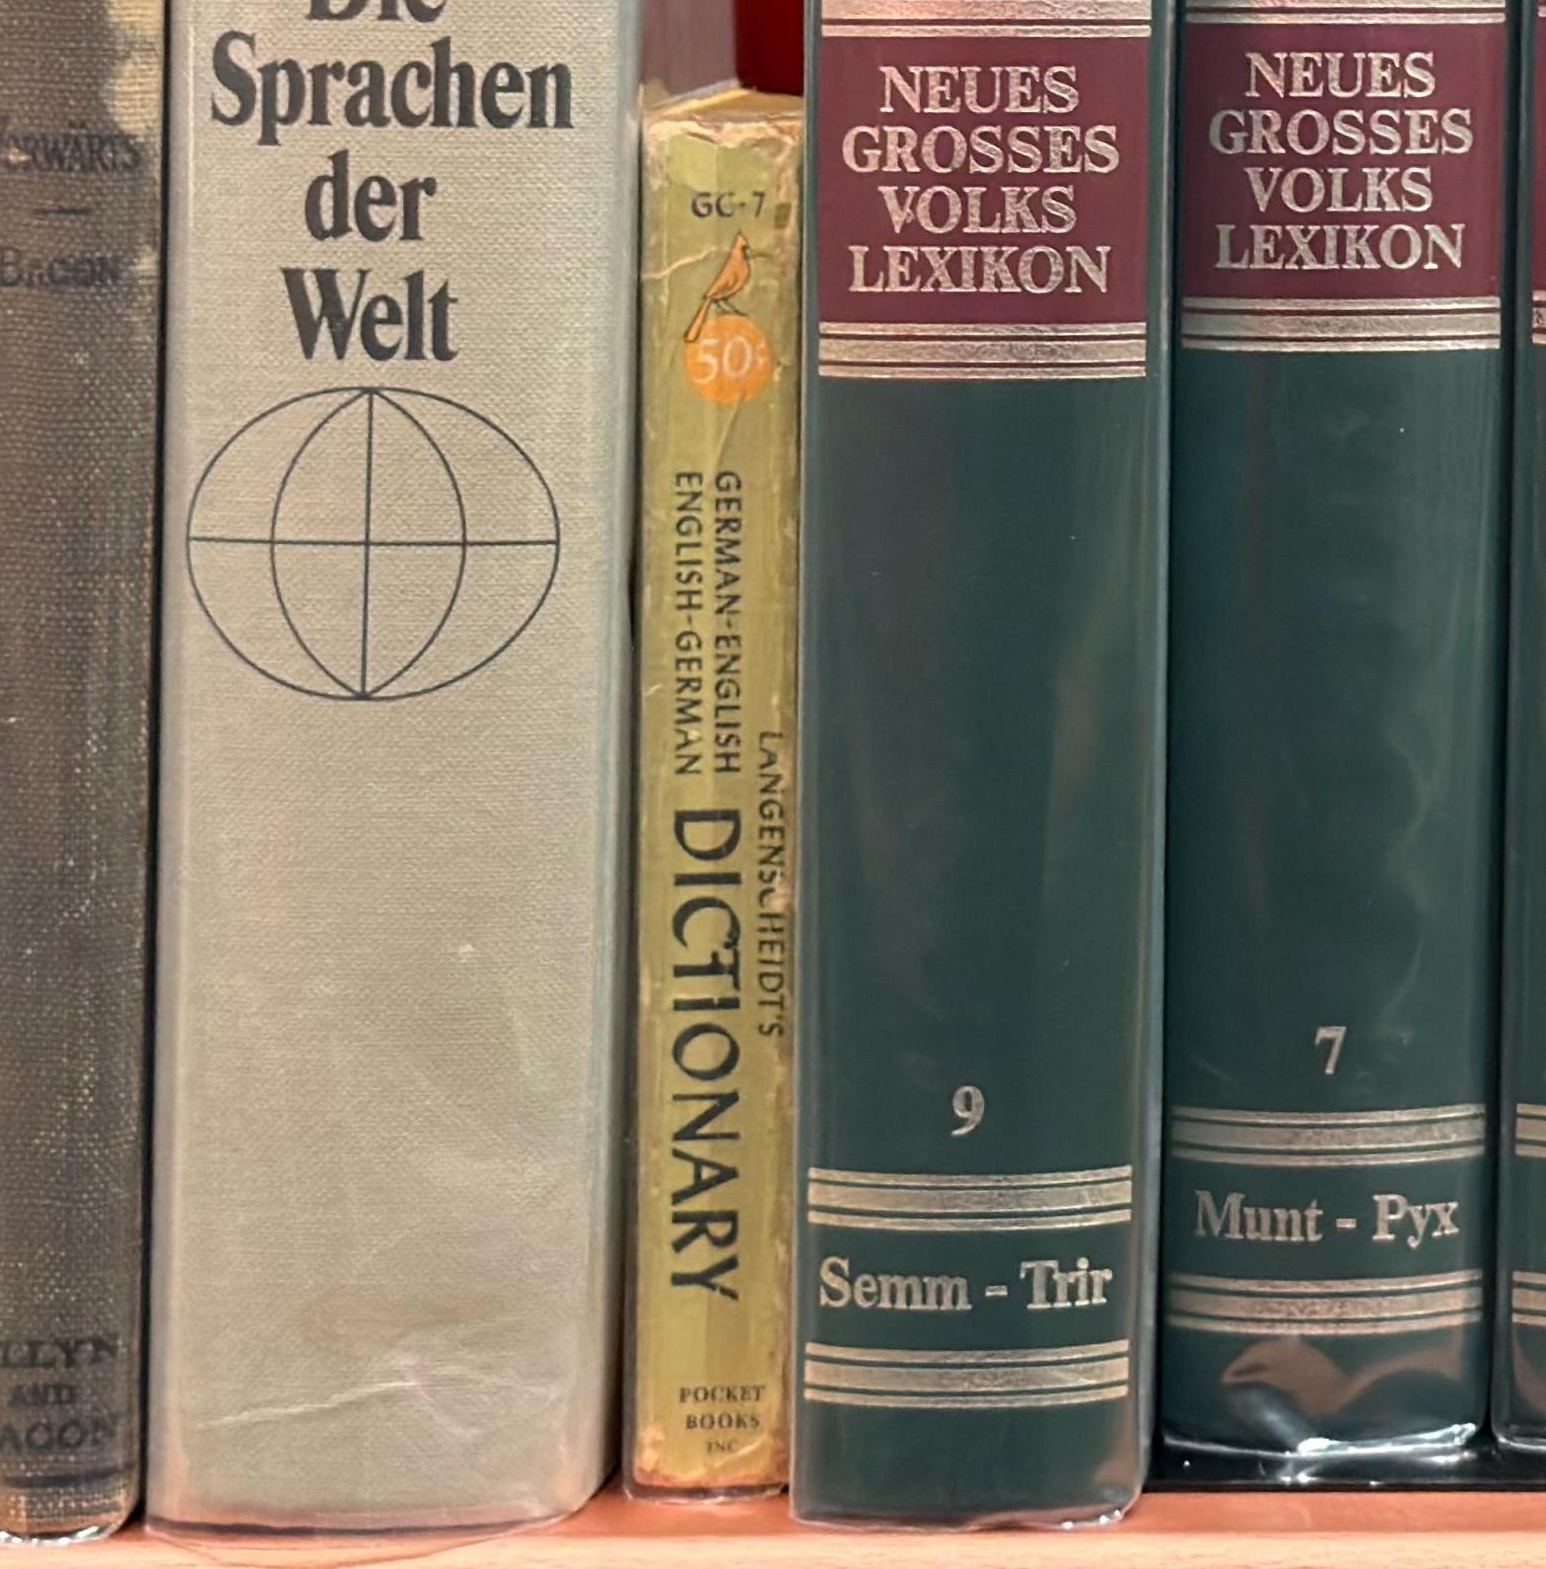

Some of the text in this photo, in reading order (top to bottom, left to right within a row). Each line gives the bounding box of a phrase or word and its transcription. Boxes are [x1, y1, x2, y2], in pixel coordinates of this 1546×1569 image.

[210, 31, 574, 148] Sprachen
[879, 65, 1081, 115] NEUES
[1244, 51, 1437, 100] NEUES
[841, 124, 1122, 175] GROSSES
[1208, 107, 1474, 157] GROSSES
[304, 149, 437, 242] der
[877, 184, 1078, 235] VOLKS
[1244, 165, 1434, 215] VOLKS
[847, 244, 1112, 295] LEXIKON
[1214, 223, 1466, 272] LEXIKON
[280, 267, 459, 363] Welt
[673, 470, 704, 777] ENGLISH-GERMAN
[714, 470, 743, 775] GERMAN-ENGLISH
[670, 808, 743, 1302] DICTIONARY
[1314, 1025, 1347, 1076] 7
[950, 1085, 987, 1136] 9
[1194, 1188, 1325, 1243] Munt
[1372, 1193, 1461, 1251] Pyx
[818, 1255, 973, 1312] Semm
[1018, 1256, 1114, 1311] Trir
[678, 1385, 766, 1405] POCKET
[685, 1412, 761, 1432] BOOKS
